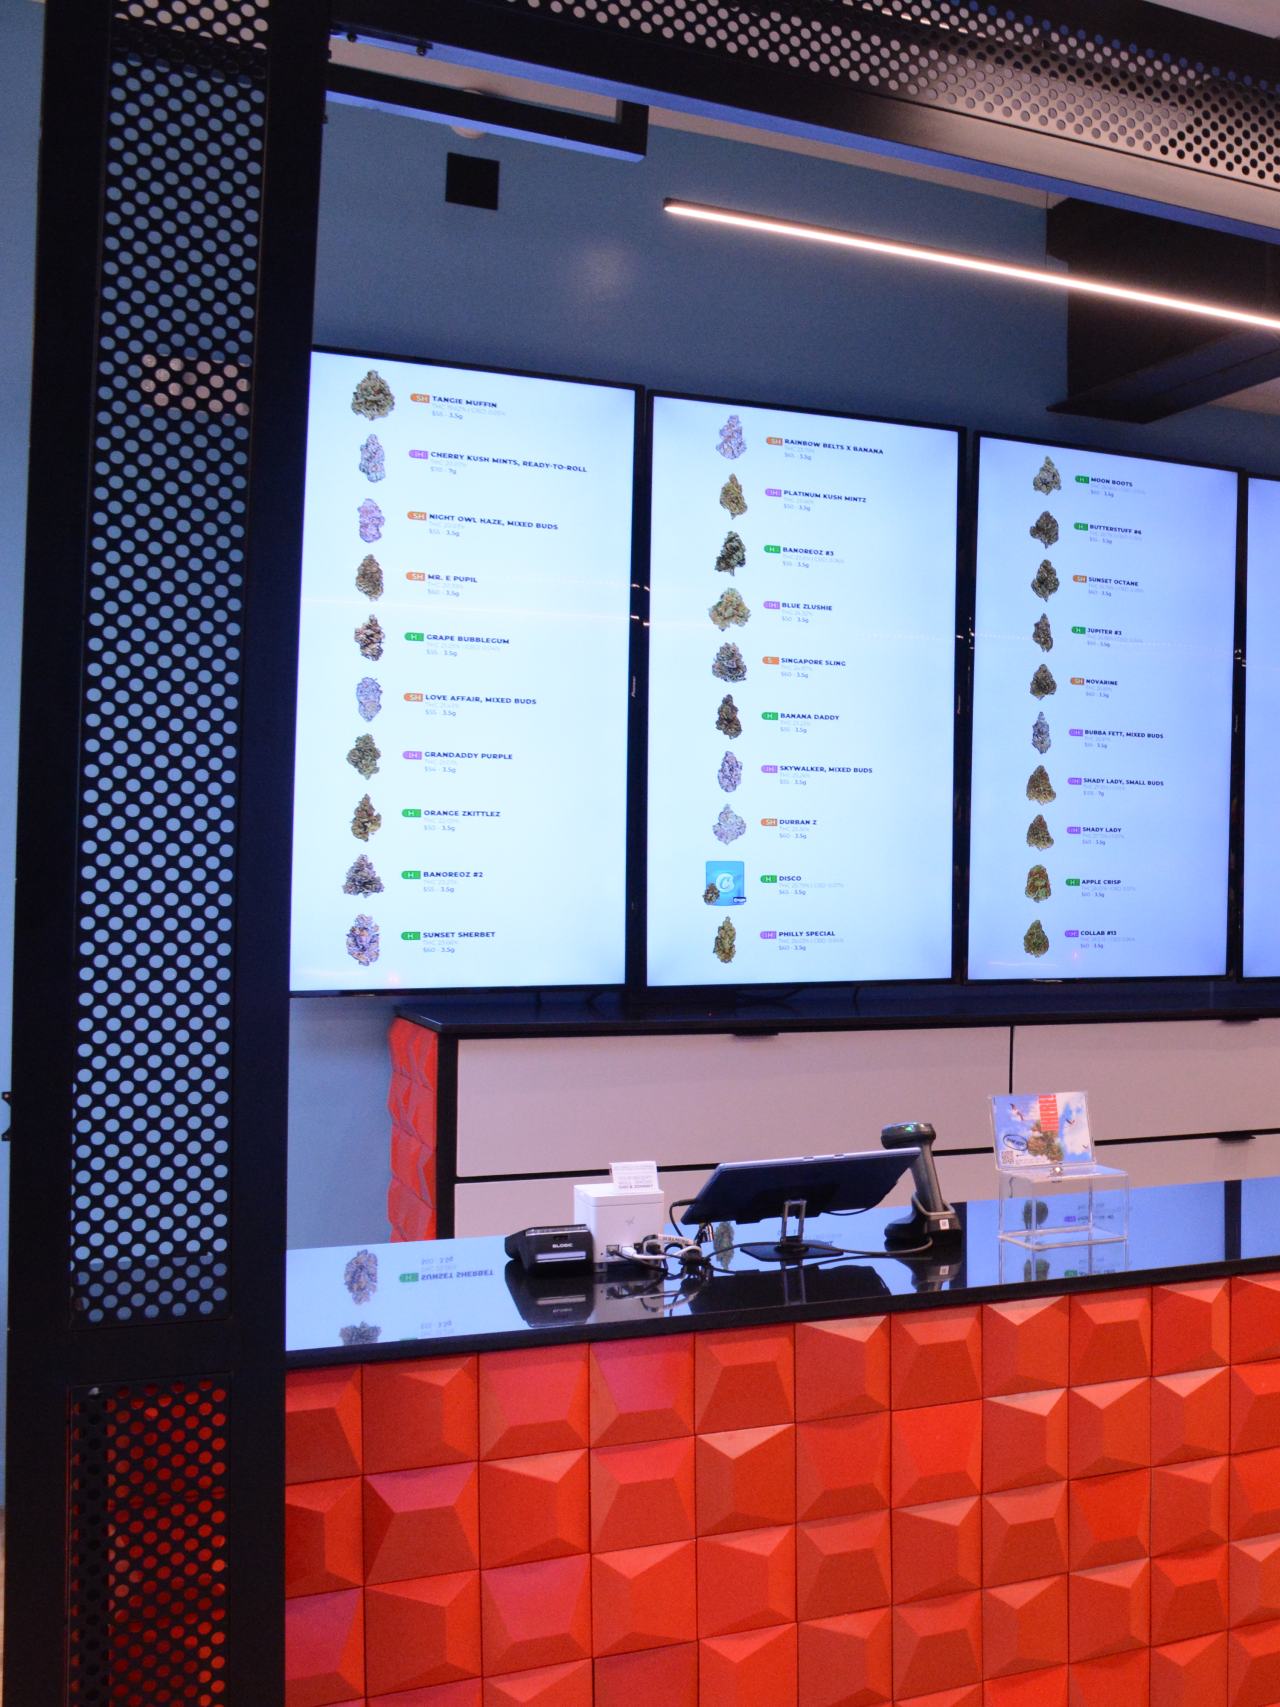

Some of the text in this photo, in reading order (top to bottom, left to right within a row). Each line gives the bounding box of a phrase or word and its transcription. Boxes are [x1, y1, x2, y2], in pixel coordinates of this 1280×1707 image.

[465, 400, 497, 408] MUFFIN
[784, 438, 821, 448] RAINBOW
[853, 446, 884, 454] BANANA
[430, 451, 464, 460] CHERRY
[492, 457, 520, 466] MINTS,
[522, 460, 587, 473] READY-TO-ROLL
[783, 490, 821, 498] PLATINUM
[480, 518, 505, 526] HAZE,
[507, 520, 534, 528] MIXED
[457, 636, 510, 644] BUBBLEGUM
